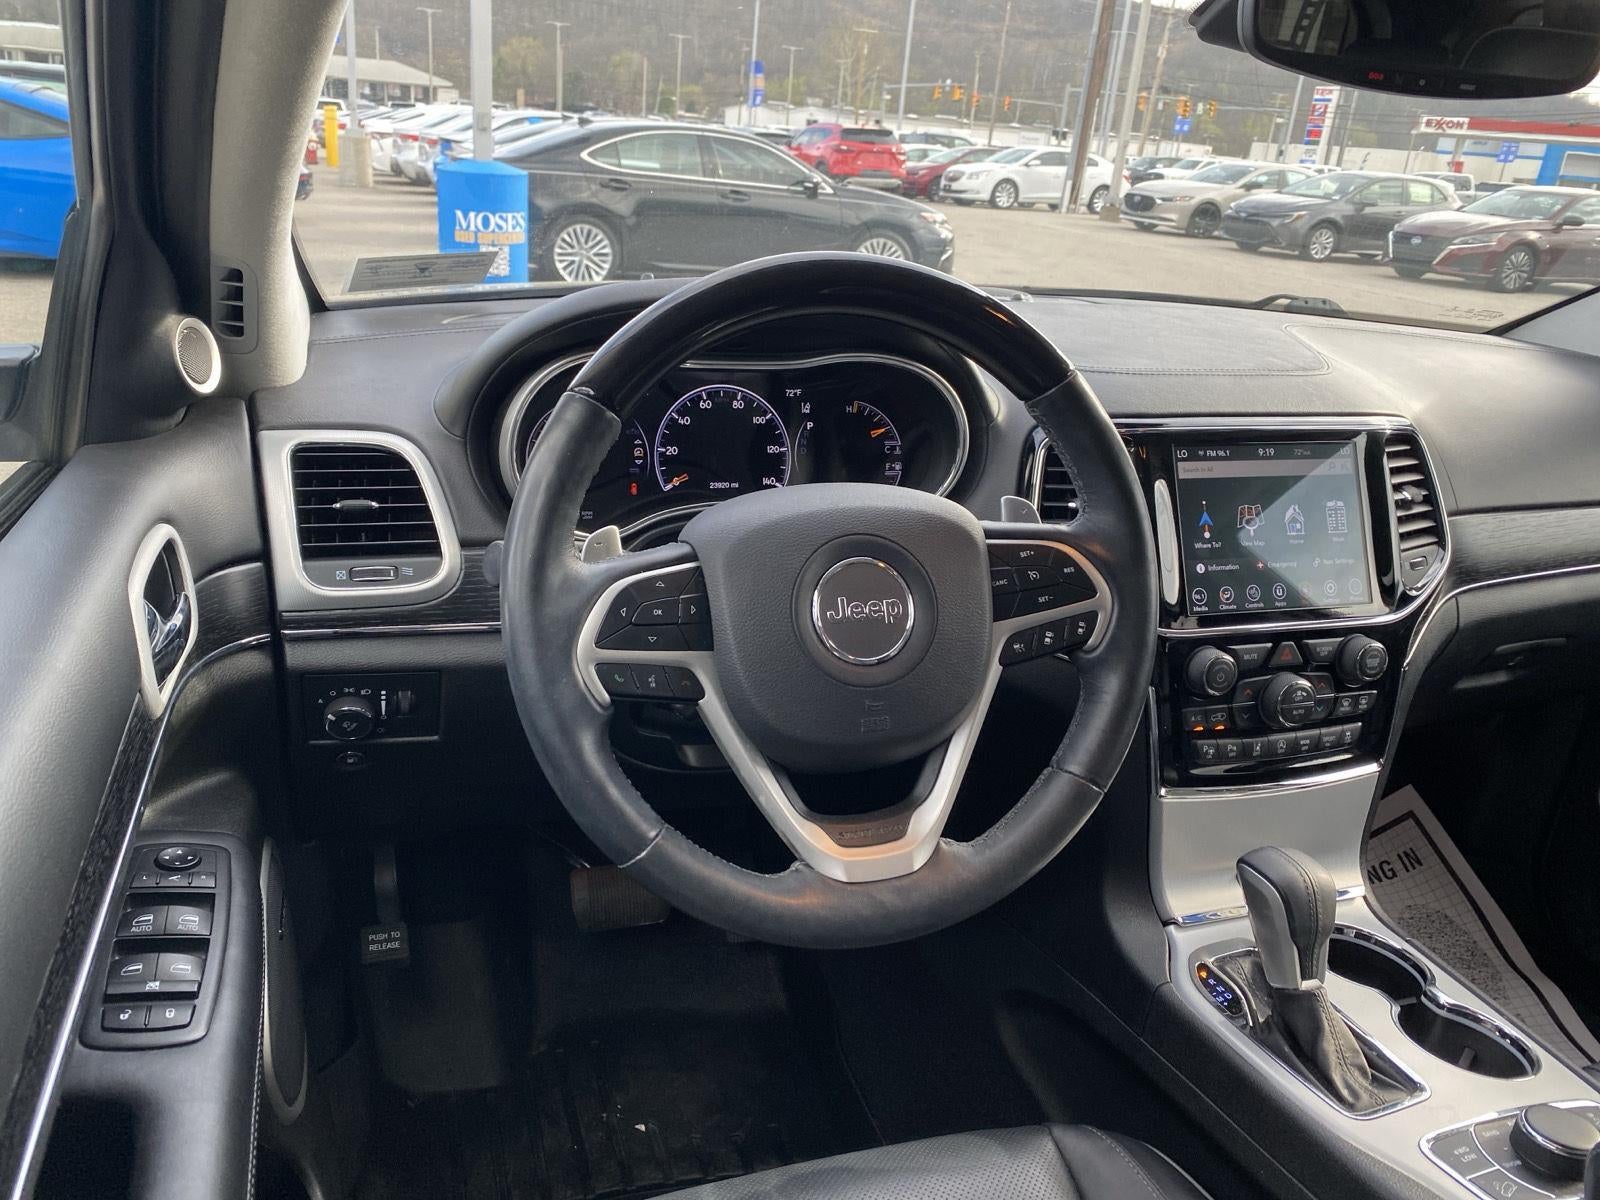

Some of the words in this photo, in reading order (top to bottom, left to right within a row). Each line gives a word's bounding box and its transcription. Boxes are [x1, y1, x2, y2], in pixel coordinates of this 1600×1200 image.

[454, 209, 526, 233] MOSES
[699, 400, 712, 409] 60
[732, 400, 745, 409] 80
[677, 416, 691, 426] 40
[752, 416, 766, 424] 100
[806, 421, 814, 430] P
[665, 446, 679, 456] 20
[766, 445, 780, 454] 120
[884, 445, 891, 454] C
[1176, 449, 1189, 459] LO
[1206, 449, 1217, 457] FM
[1257, 447, 1275, 457] 9:19
[885, 462, 891, 471] F
[762, 476, 776, 486] 140
[709, 482, 730, 490] 23920
[1207, 563, 1240, 572] Information
[653, 608, 663, 616] OK
[826, 596, 903, 624] Jeep
[1397, 847, 1424, 873] IN
[368, 933, 389, 942] PUSH
[368, 941, 401, 951] RELEASE
